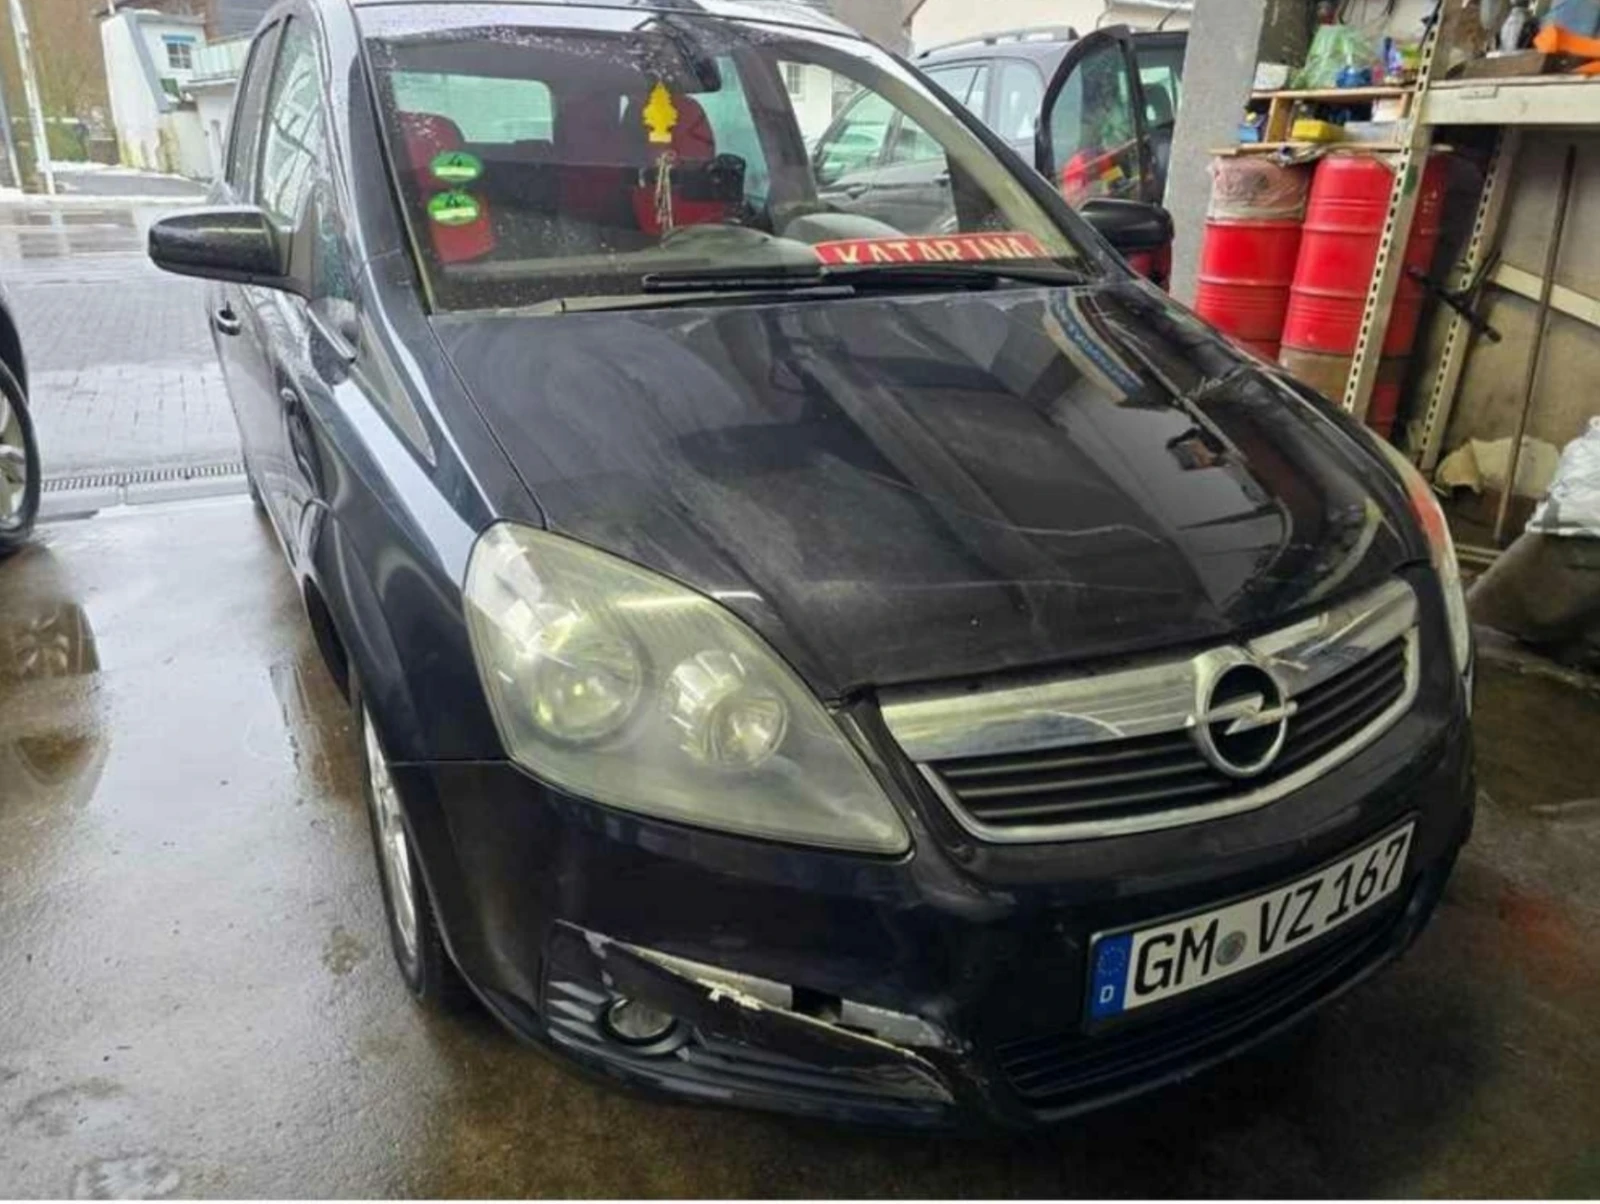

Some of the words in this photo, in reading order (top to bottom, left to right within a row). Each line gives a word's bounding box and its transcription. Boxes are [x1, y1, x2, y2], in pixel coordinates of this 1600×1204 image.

[833, 236, 1034, 264] KATARINA
[1134, 918, 1219, 996] GM
[1259, 878, 1324, 953] VZ
[1325, 832, 1409, 924] 167
[1099, 985, 1115, 1004] D
